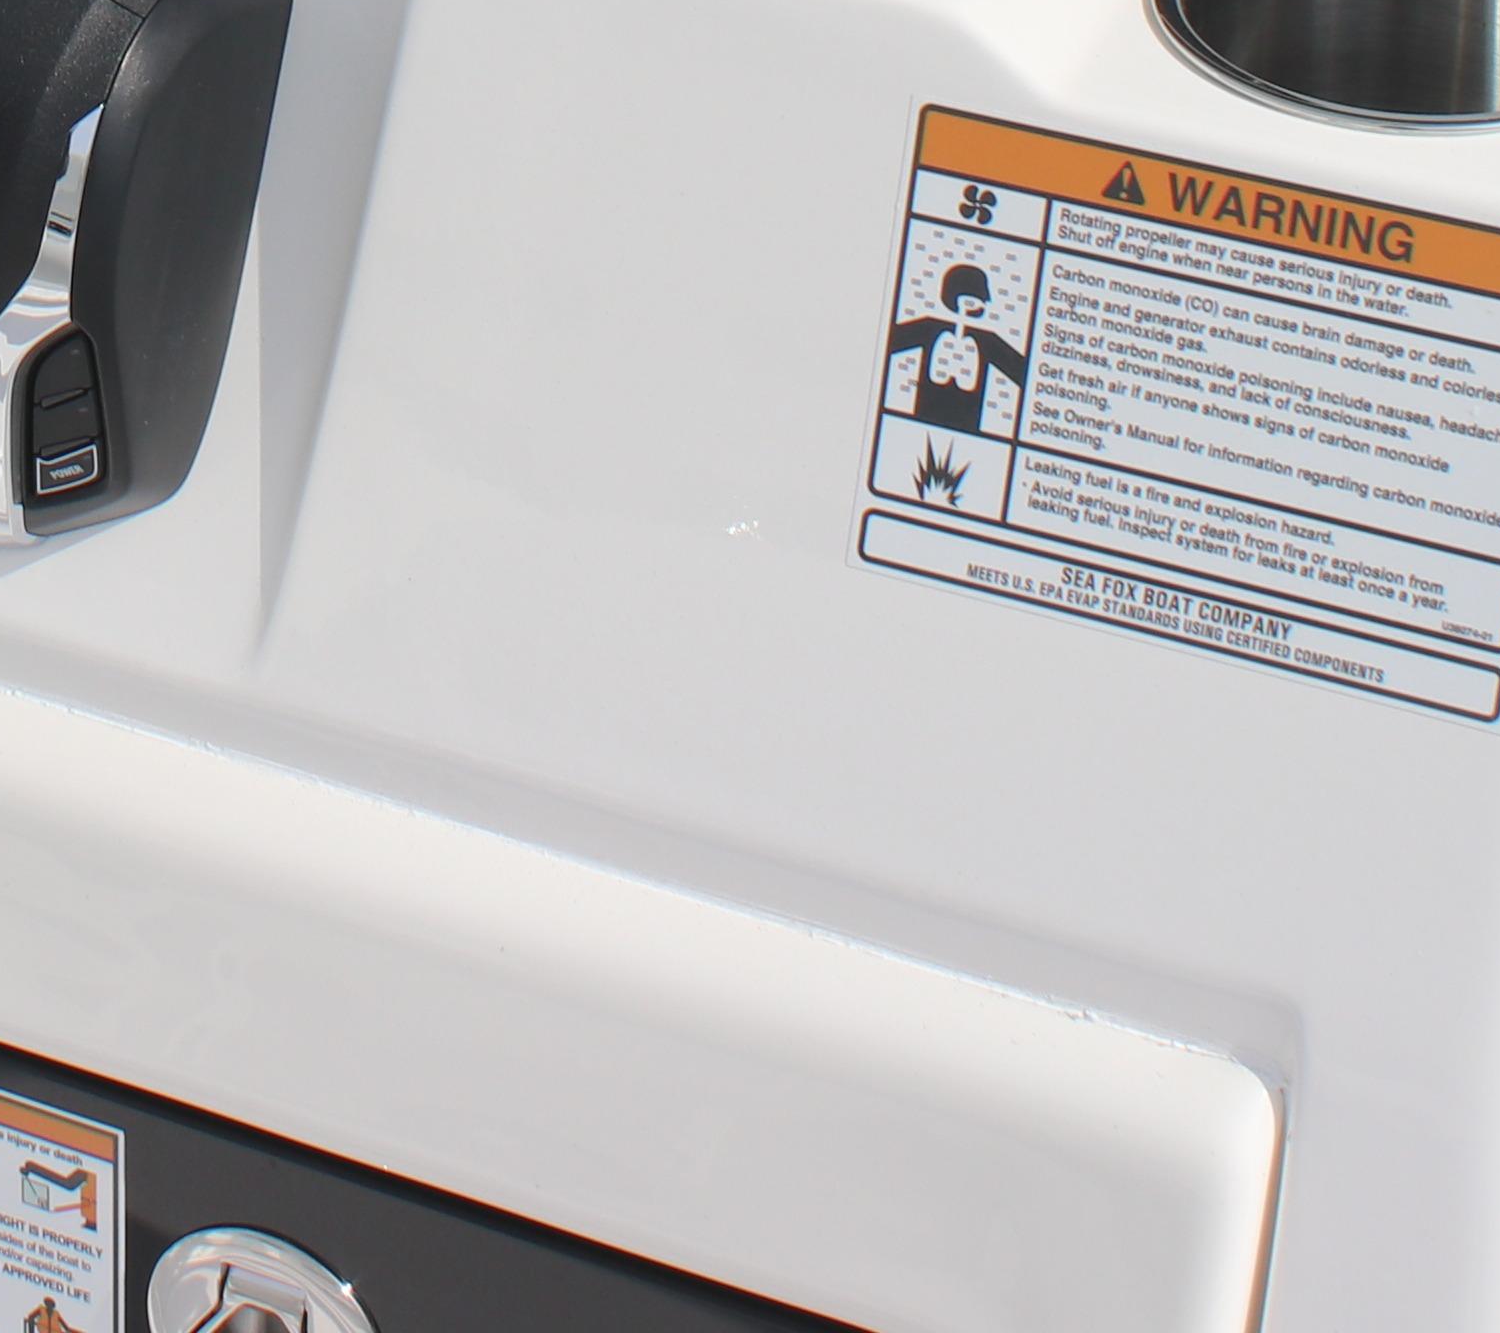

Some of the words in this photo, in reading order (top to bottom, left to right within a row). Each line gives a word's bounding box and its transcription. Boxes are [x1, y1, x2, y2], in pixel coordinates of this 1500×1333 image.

[1058, 207, 1123, 239] Rotating
[1123, 222, 1192, 255] propeller
[1193, 241, 1227, 263] may
[1228, 249, 1276, 270] cause
[1277, 256, 1336, 283] serious
[1336, 269, 1383, 297] injury
[1384, 283, 1402, 298] or
[1404, 284, 1453, 309] death.
[1163, 171, 1418, 265] WARNING
[1051, 263, 1106, 290] Carbon
[1107, 276, 1182, 307] monoxide
[1183, 293, 1220, 319] (CO)
[1221, 305, 1250, 323] can
[1252, 312, 1299, 334] cause
[1300, 320, 1342, 343] brain
[1342, 329, 1406, 362] damage
[1407, 347, 1425, 362] or
[1427, 348, 1477, 374] death.
[1056, 223, 1093, 246] Shut
[1094, 232, 1116, 251] off
[1117, 237, 1170, 267] engine
[1171, 249, 1213, 273] when
[1214, 262, 1250, 281] near
[1250, 271, 1315, 299] persons
[1316, 281, 1333, 299] in
[1334, 285, 1361, 306] the
[1362, 292, 1411, 317] water.
[1042, 321, 1086, 349] Signs
[1087, 332, 1105, 350] of
[1106, 336, 1160, 363] carbon
[1161, 349, 1236, 381] monoxide
[1236, 367, 1314, 403] poisoning
[1315, 385, 1374, 413] include
[1374, 403, 1436, 431] nausea,
[1045, 302, 1099, 328] carbon
[1099, 314, 1174, 346] monoxide
[1175, 335, 1207, 357] gas.
[1047, 285, 1101, 315] Engine
[1101, 298, 1132, 319] and
[1132, 305, 1206, 339] generator
[1207, 322, 1269, 350] exhaust
[1270, 336, 1338, 366] contains
[1339, 352, 1408, 382] odorless
[1408, 367, 1441, 389] and
[1037, 361, 1065, 382] Get
[1066, 368, 1106, 392] fresh
[1106, 378, 1128, 397] air
[1129, 383, 1142, 400] if
[1142, 390, 1199, 418] anyone
[1200, 400, 1252, 426] shows
[1252, 413, 1297, 441] signs
[1297, 423, 1316, 442] of
[1316, 428, 1372, 455] carbon
[1372, 441, 1451, 474] monoxide
[50, 464, 84, 480] POWER
[1023, 455, 1083, 487] Leaking
[1084, 470, 1114, 491] fuel
[1115, 478, 1131, 496] is
[1131, 486, 1143, 499] a
[1144, 485, 1171, 506] fire
[1172, 492, 1202, 513] and
[1202, 499, 1278, 536] explosion
[1279, 518, 1336, 546] hazard.
[966, 562, 1009, 587] MEETS
[1011, 574, 1037, 596] U.S.
[1039, 581, 1064, 602] EPA
[1066, 588, 1101, 611] EVAP
[1102, 597, 1181, 631] STANDARDS
[1182, 618, 1225, 642] USING
[1226, 629, 1292, 660] CERTIFIED
[1293, 646, 1385, 684] COMPONENTS
[1060, 566, 1097, 589] SEA
[1101, 575, 1138, 601] FOX
[1143, 586, 1194, 615] BOAT
[1198, 600, 1294, 642] COMPANY
